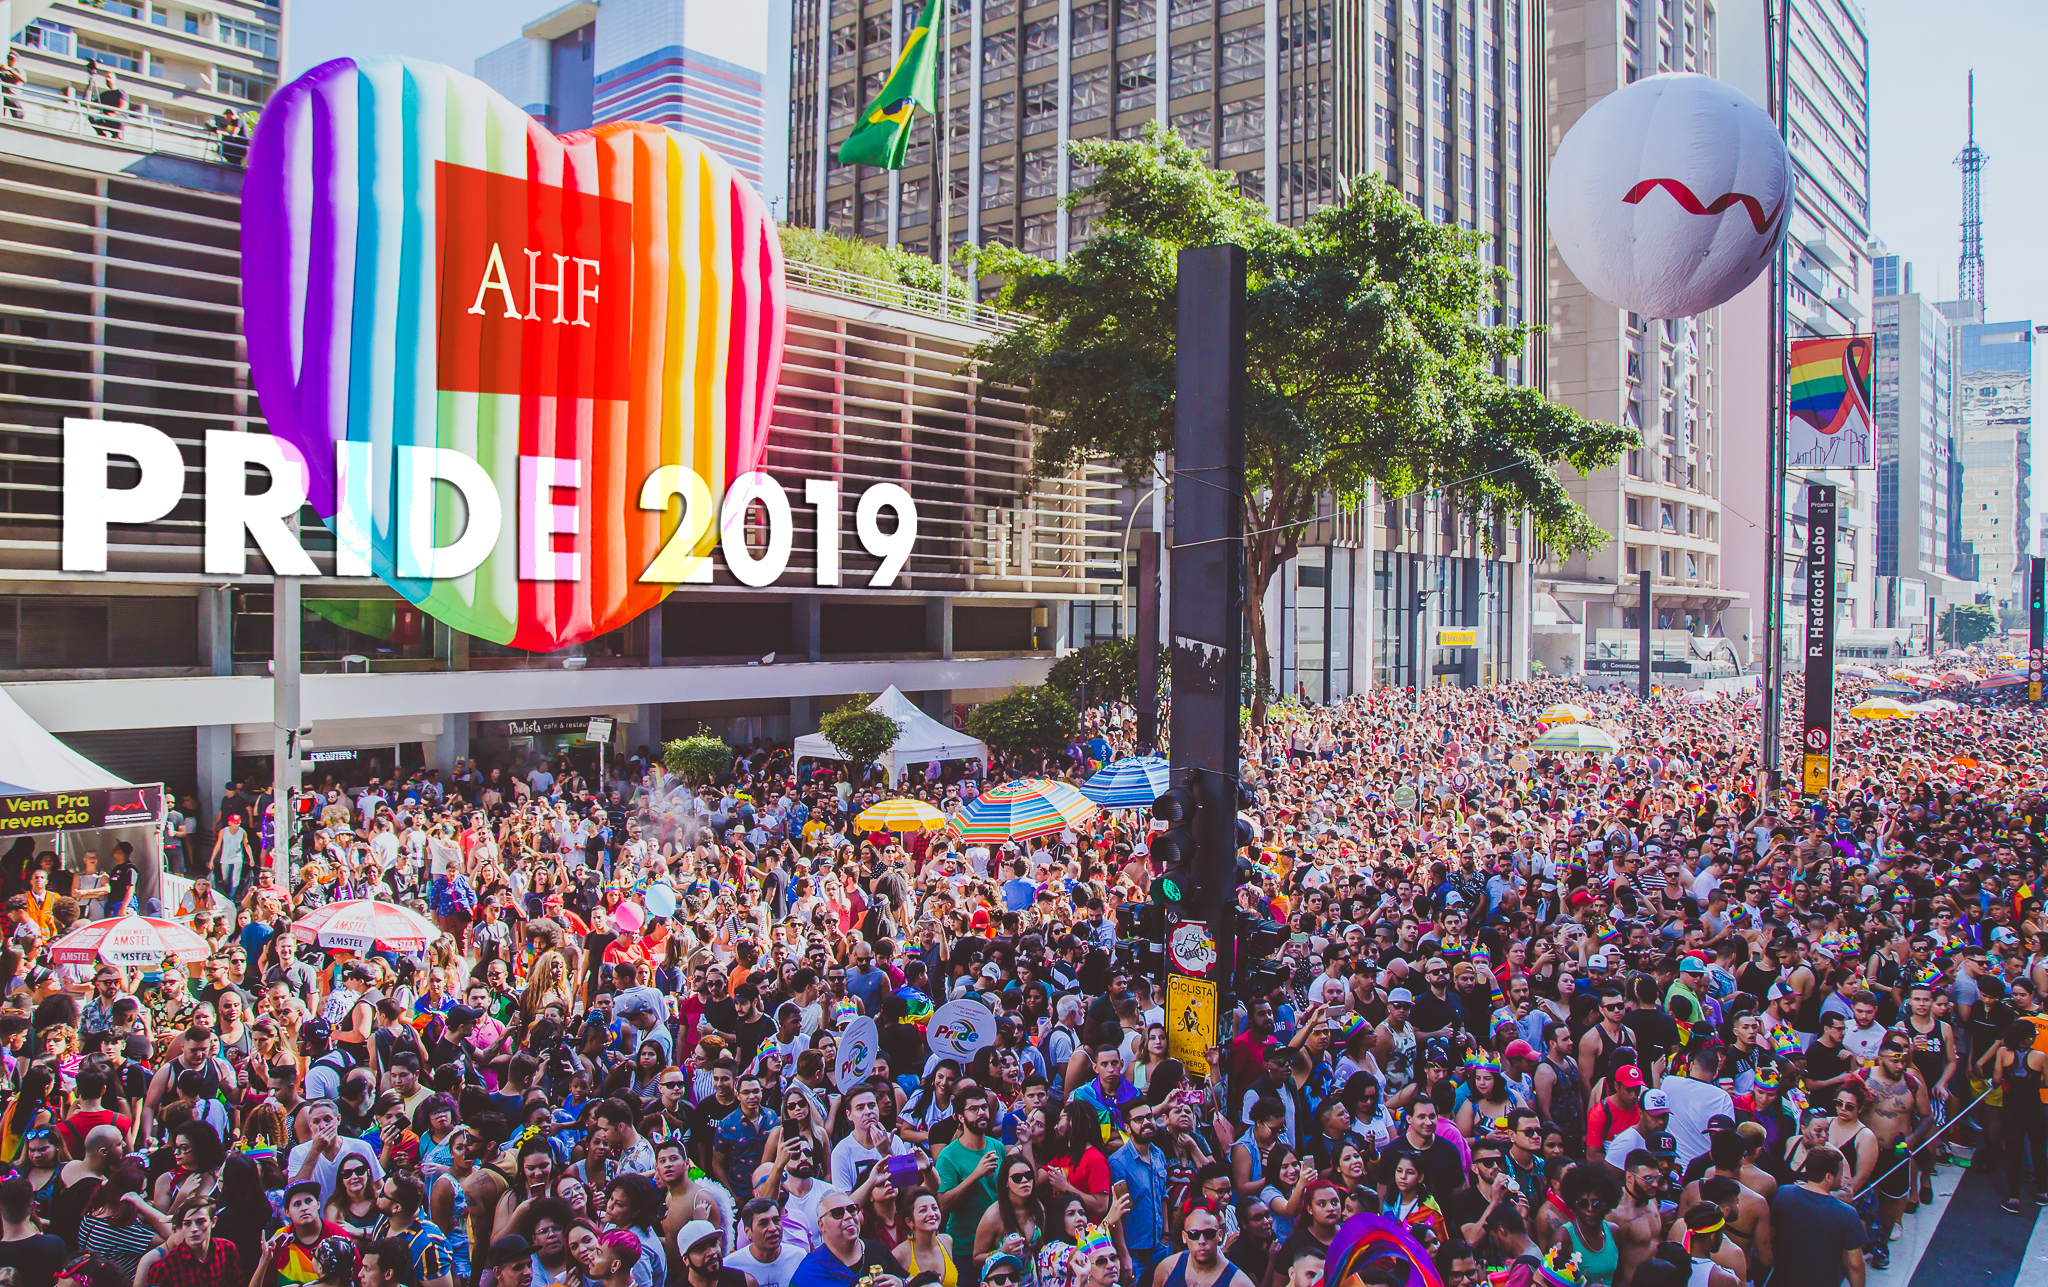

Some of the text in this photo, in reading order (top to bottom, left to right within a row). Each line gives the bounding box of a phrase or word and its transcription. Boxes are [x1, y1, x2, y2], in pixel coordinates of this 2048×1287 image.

[1809, 526, 1826, 657] R. Haddock Lobo
[507, 720, 541, 735] Paulista
[565, 720, 589, 729] restau
[6, 794, 90, 813] Vem Pra
[0, 809, 90, 829] revenção
[332, 920, 368, 933] AMSTEL
[113, 935, 152, 946] AMSTEL
[328, 936, 363, 948] AMSTEL
[60, 952, 90, 961] AMSTEL
[112, 952, 152, 961] AMSTEL
[1170, 981, 1213, 998] CICLISTA
[934, 1025, 979, 1043] Pride
[949, 1024, 966, 1032] EXPO
[841, 1046, 868, 1080] Pride
[1184, 1059, 1207, 1070] VERDE
